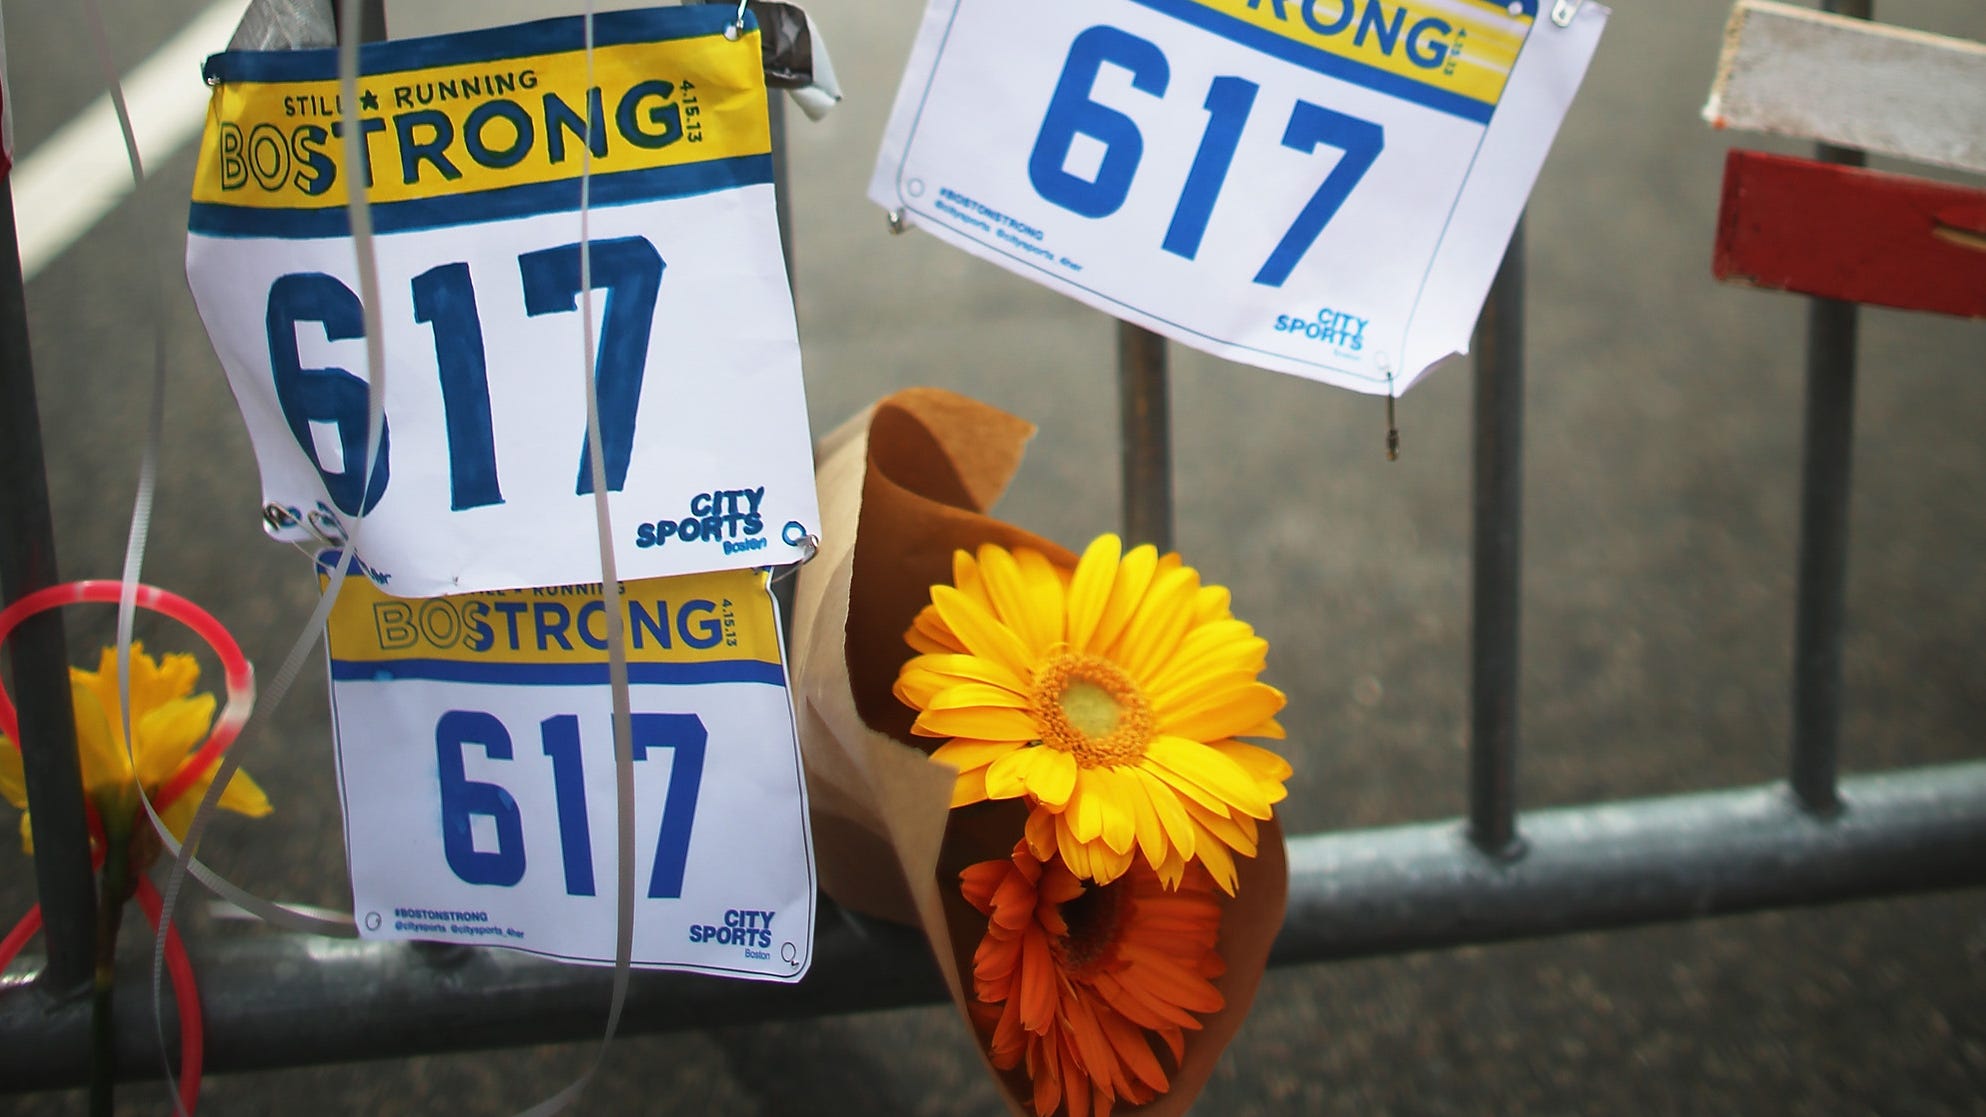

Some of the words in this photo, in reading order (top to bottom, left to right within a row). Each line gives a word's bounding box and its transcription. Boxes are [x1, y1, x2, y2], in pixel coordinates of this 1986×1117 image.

[394, 70, 538, 109] RUNNING
[680, 80, 703, 143] 4.15.13
[219, 79, 683, 196] BOSTRONG
[1028, 24, 1386, 288] 617
[1273, 314, 1363, 351] SPORTS
[1318, 307, 1369, 337] CITY
[265, 235, 667, 518] 617
[690, 485, 765, 517] CITY
[635, 512, 764, 549] SPORTS
[373, 597, 724, 653] BOSTRONG
[723, 599, 737, 647] 4.15.13
[435, 710, 709, 899] 617
[394, 908, 489, 922] #BOSTONSTRONG
[724, 909, 776, 930] CITY
[689, 924, 772, 948] SPORTS
[744, 948, 771, 960] Boston
